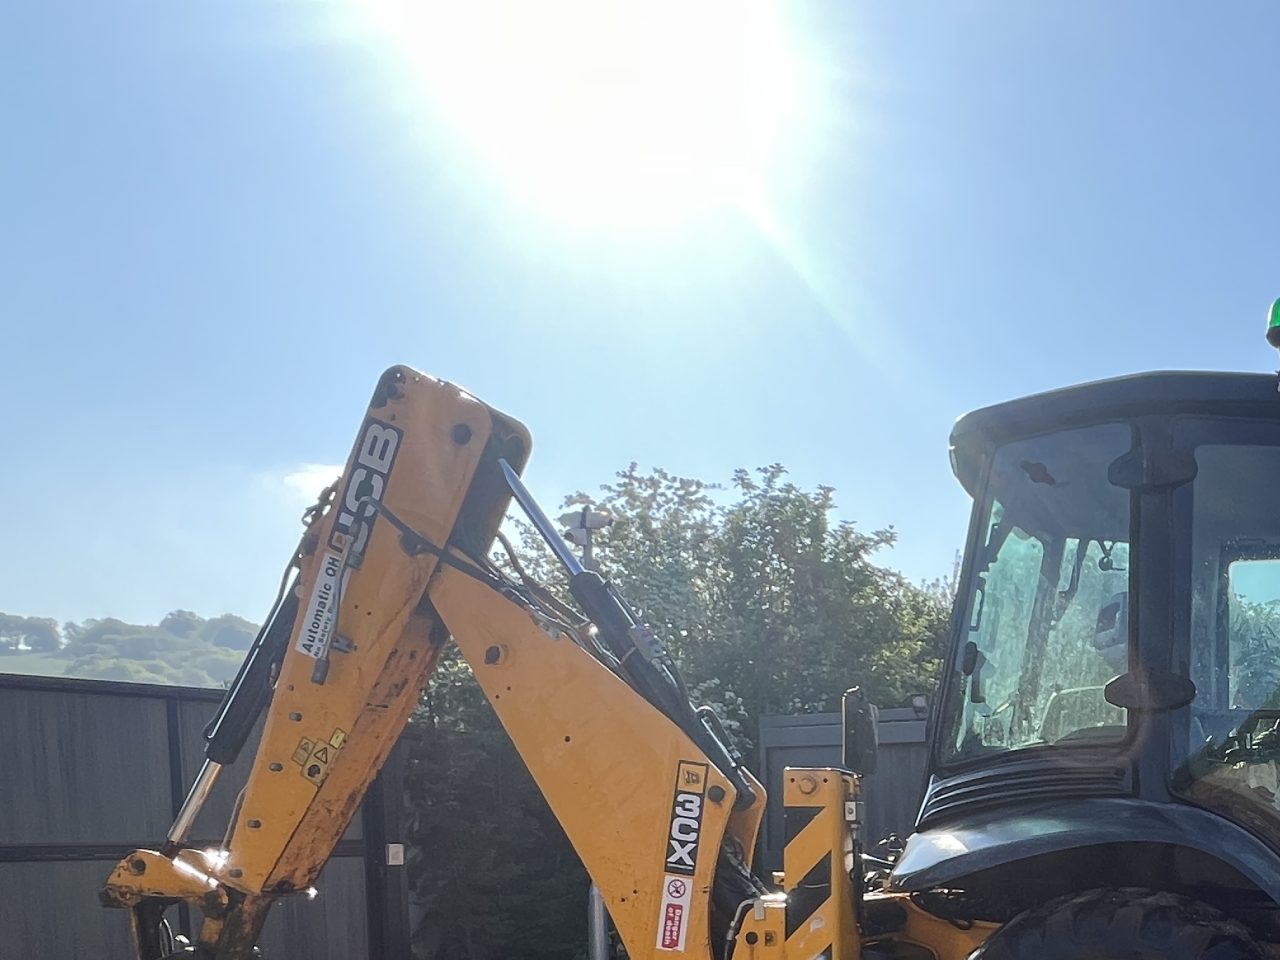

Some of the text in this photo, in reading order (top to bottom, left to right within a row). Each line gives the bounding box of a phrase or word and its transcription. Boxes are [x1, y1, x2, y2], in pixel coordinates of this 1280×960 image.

[338, 422, 400, 557] JCB
[301, 584, 333, 653] Automatic
[325, 556, 341, 579] QH
[666, 793, 701, 866] 3CX
[664, 907, 674, 945] of death
[671, 909, 682, 940] Danger
